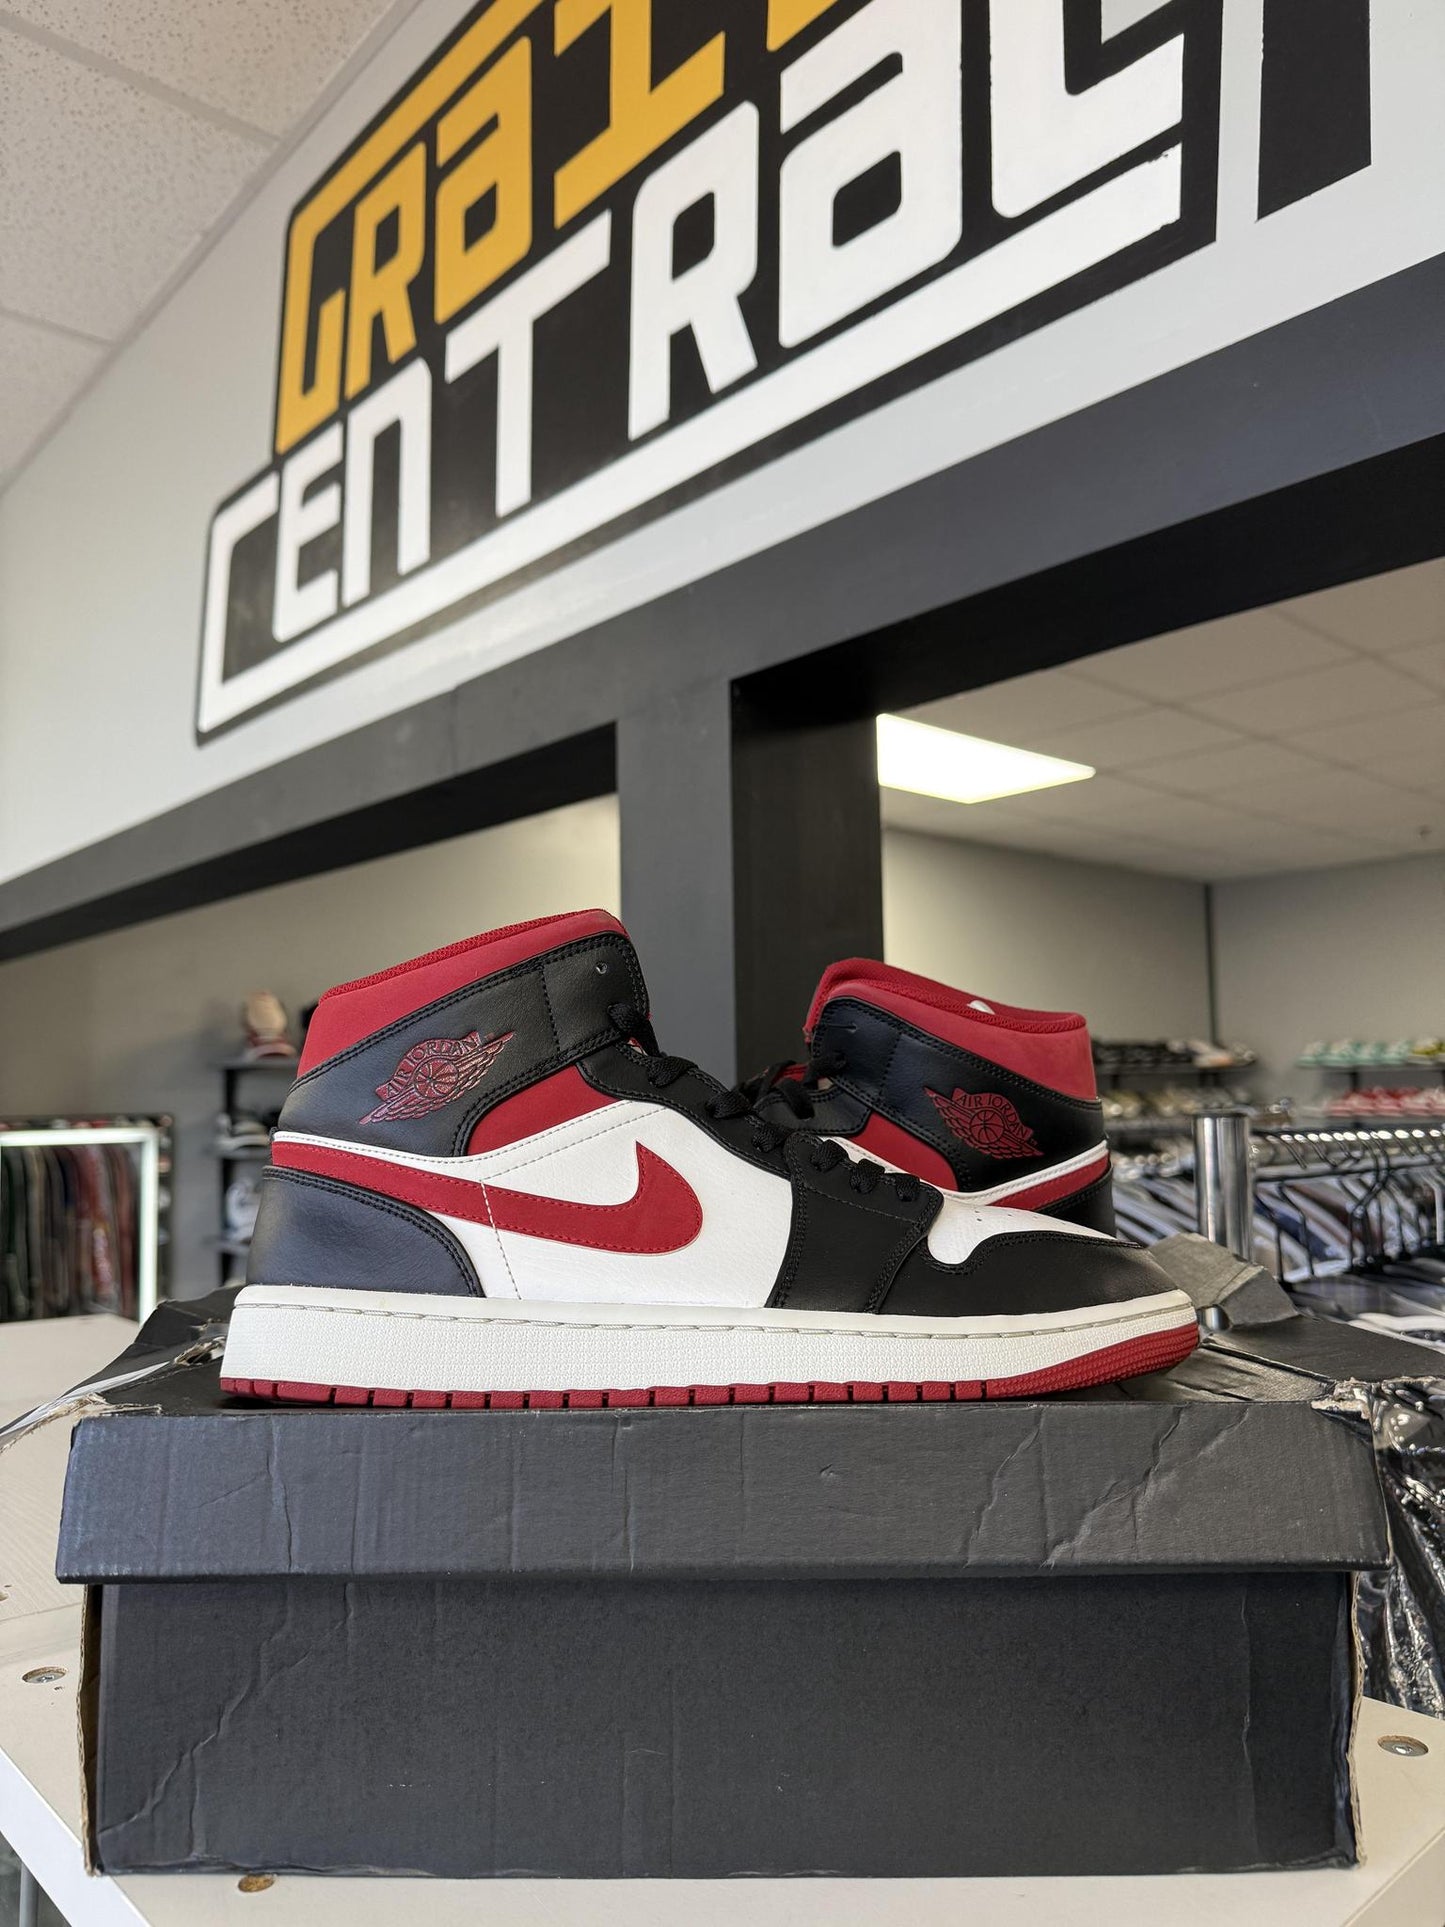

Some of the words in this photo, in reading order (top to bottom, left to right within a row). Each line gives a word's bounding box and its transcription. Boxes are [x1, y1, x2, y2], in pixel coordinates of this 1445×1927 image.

[387, 1068, 412, 1098] AIR
[404, 1031, 481, 1067] JORDAN
[955, 1094, 983, 1107] AIR
[988, 1094, 1028, 1139] JORDAN
